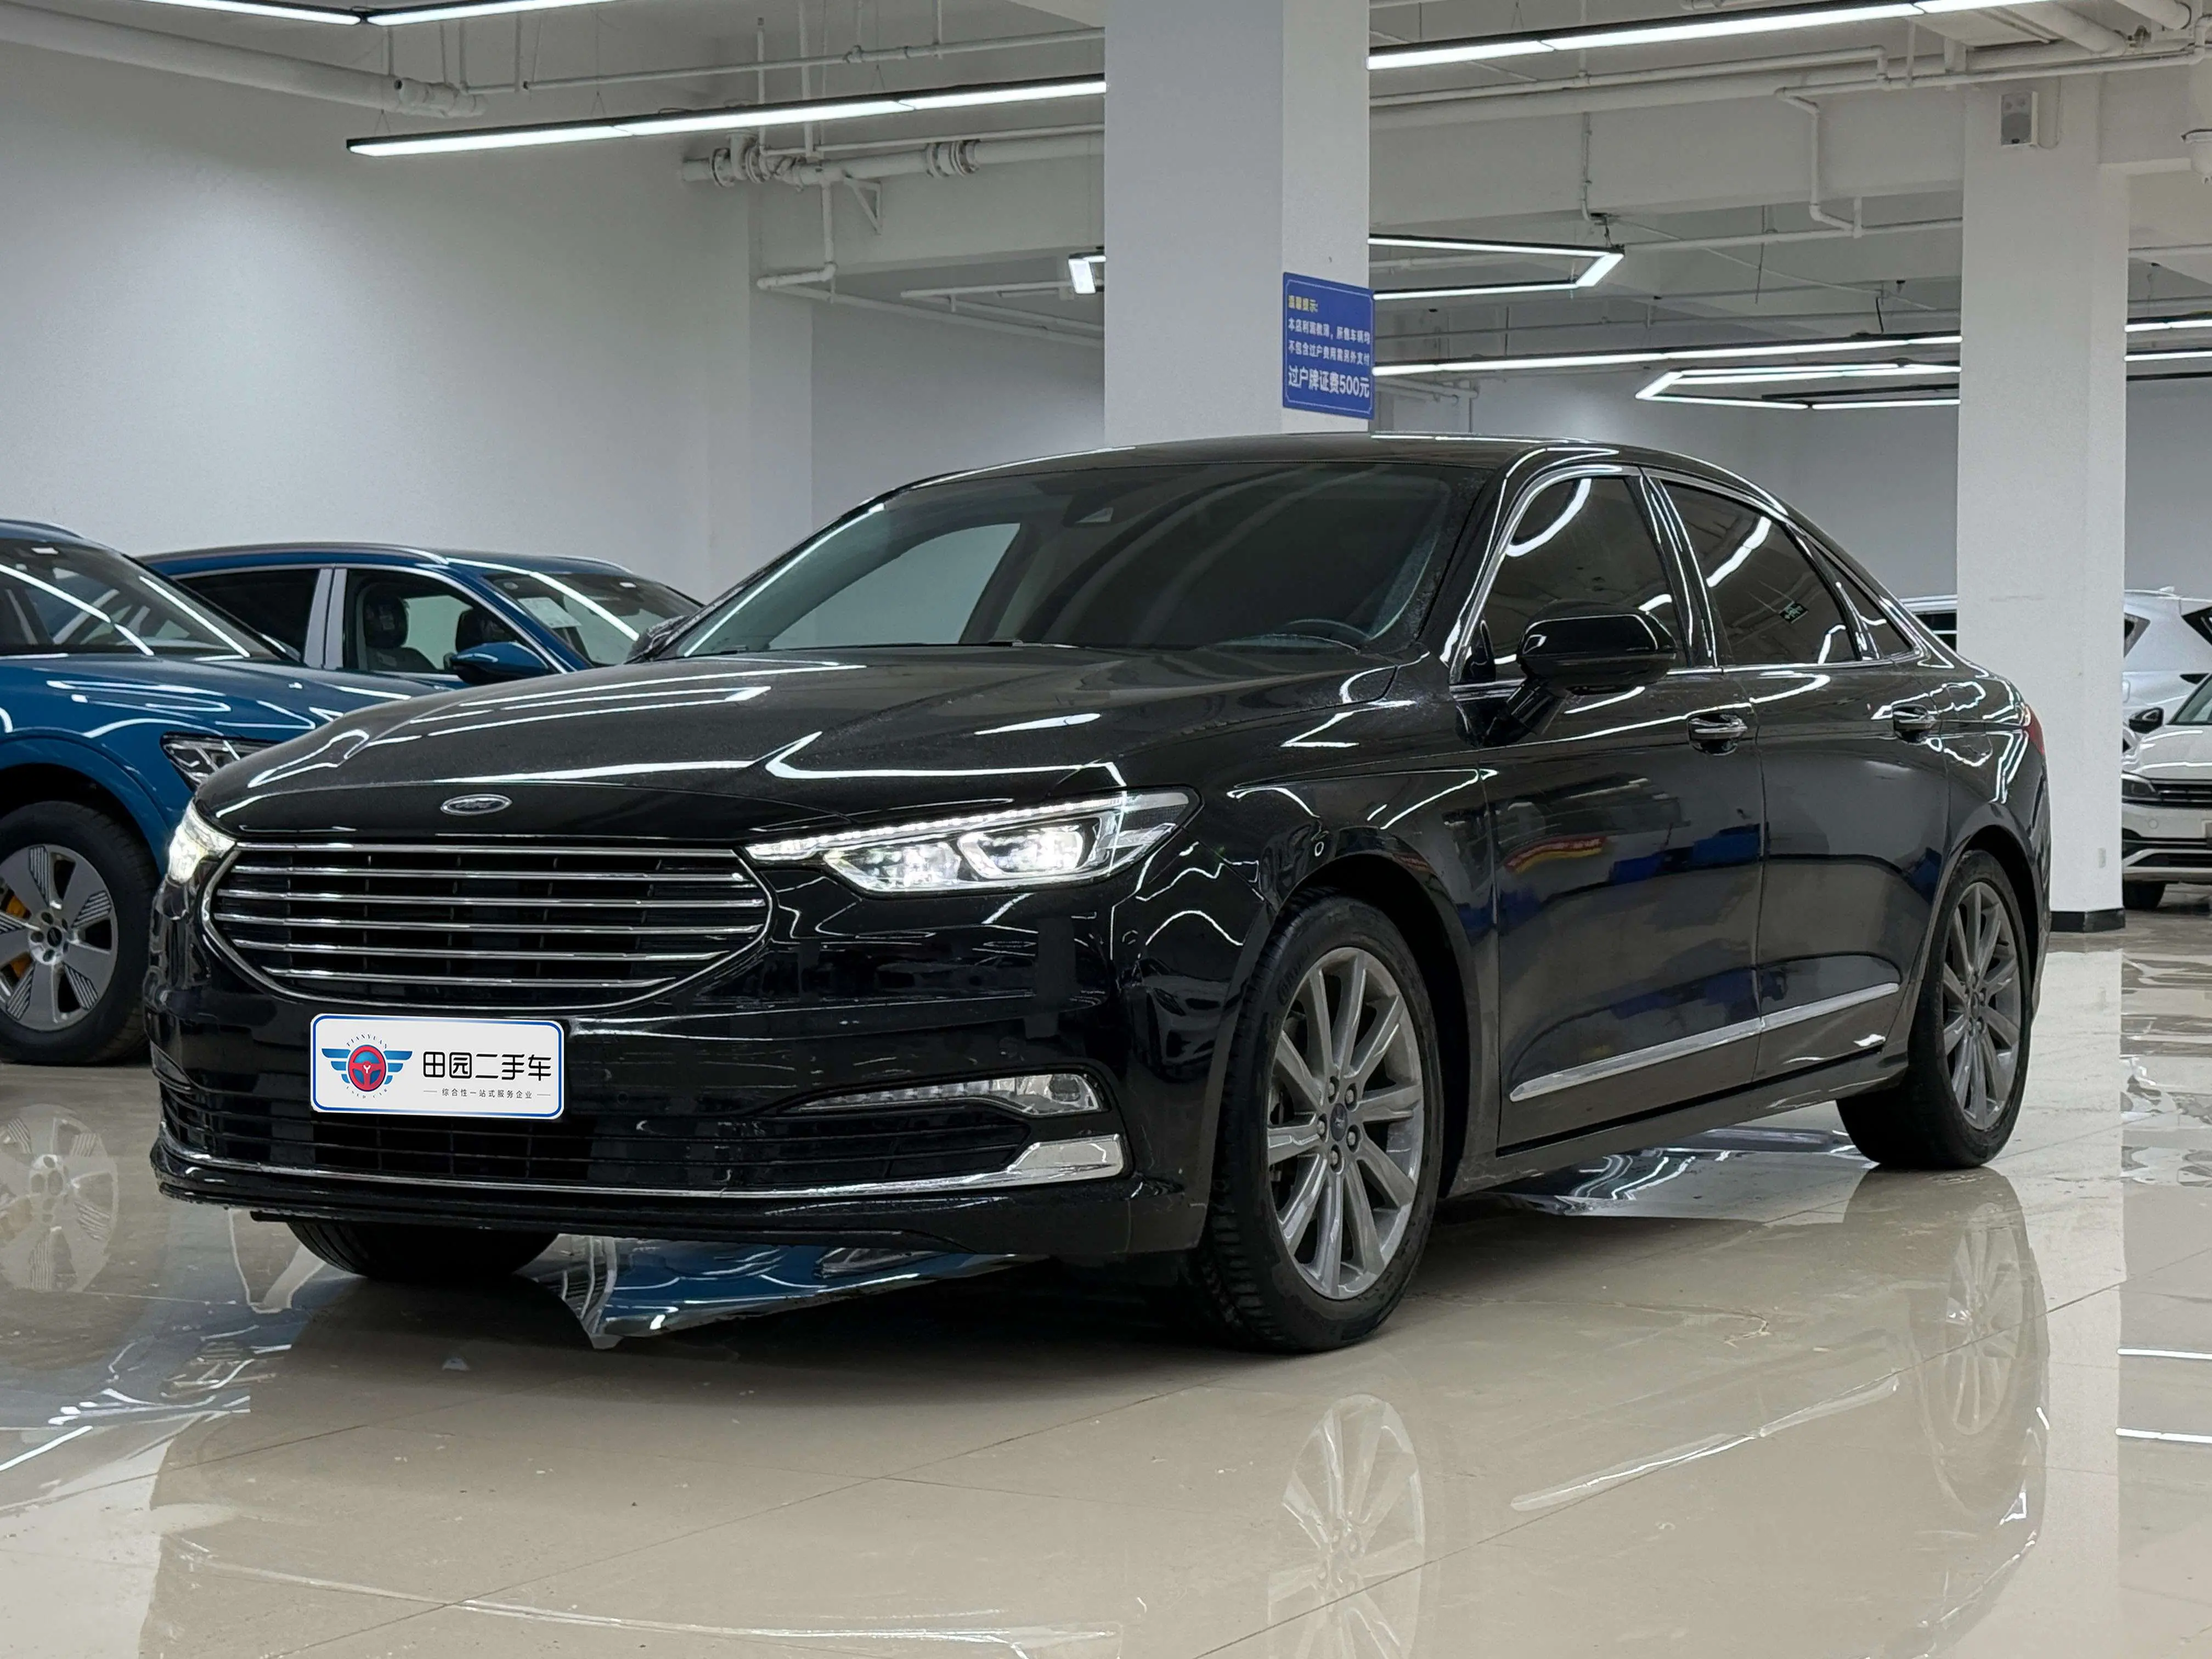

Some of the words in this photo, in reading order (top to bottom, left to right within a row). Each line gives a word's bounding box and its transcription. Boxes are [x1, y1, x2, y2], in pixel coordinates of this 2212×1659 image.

[1289, 365, 1369, 398] 过户牌证费500元
